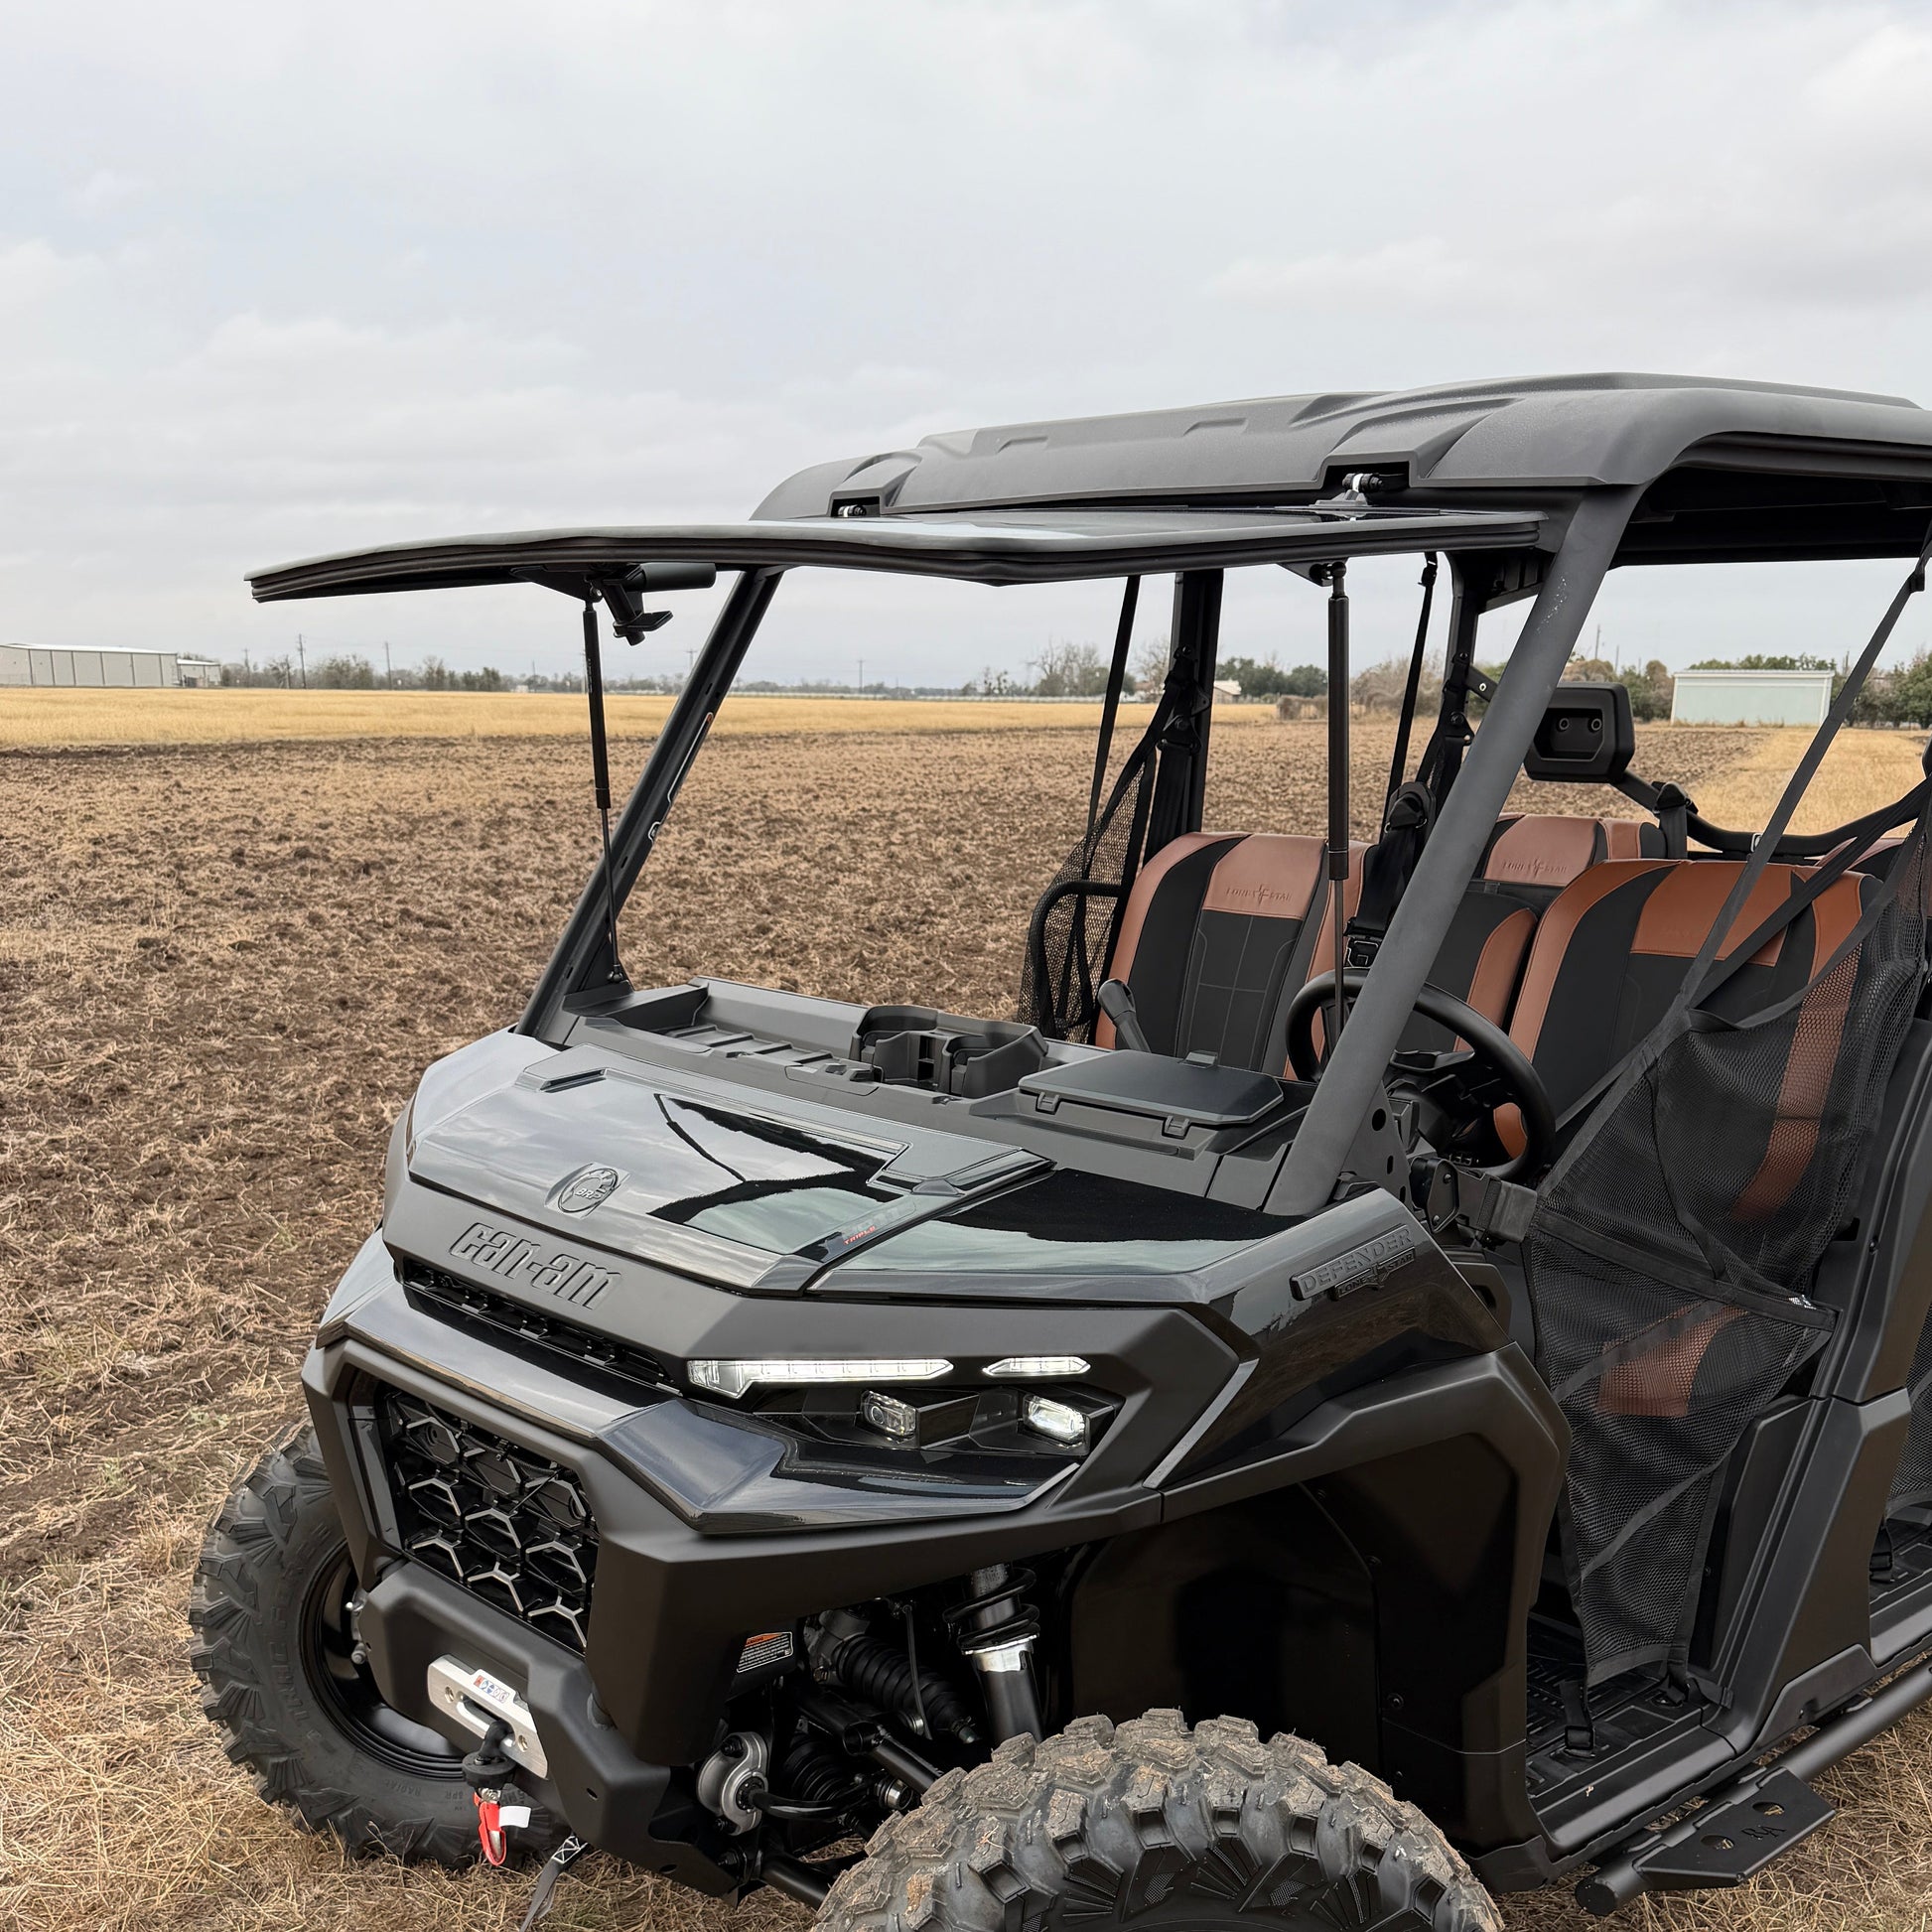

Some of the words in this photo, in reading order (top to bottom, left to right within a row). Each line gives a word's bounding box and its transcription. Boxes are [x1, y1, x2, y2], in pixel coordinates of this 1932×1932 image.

[575, 1187, 602, 1200] BRP
[1300, 1227, 1412, 1294] DEFENDER
[1337, 1274, 1368, 1295] LONE
[1387, 1252, 1413, 1271] STAR
